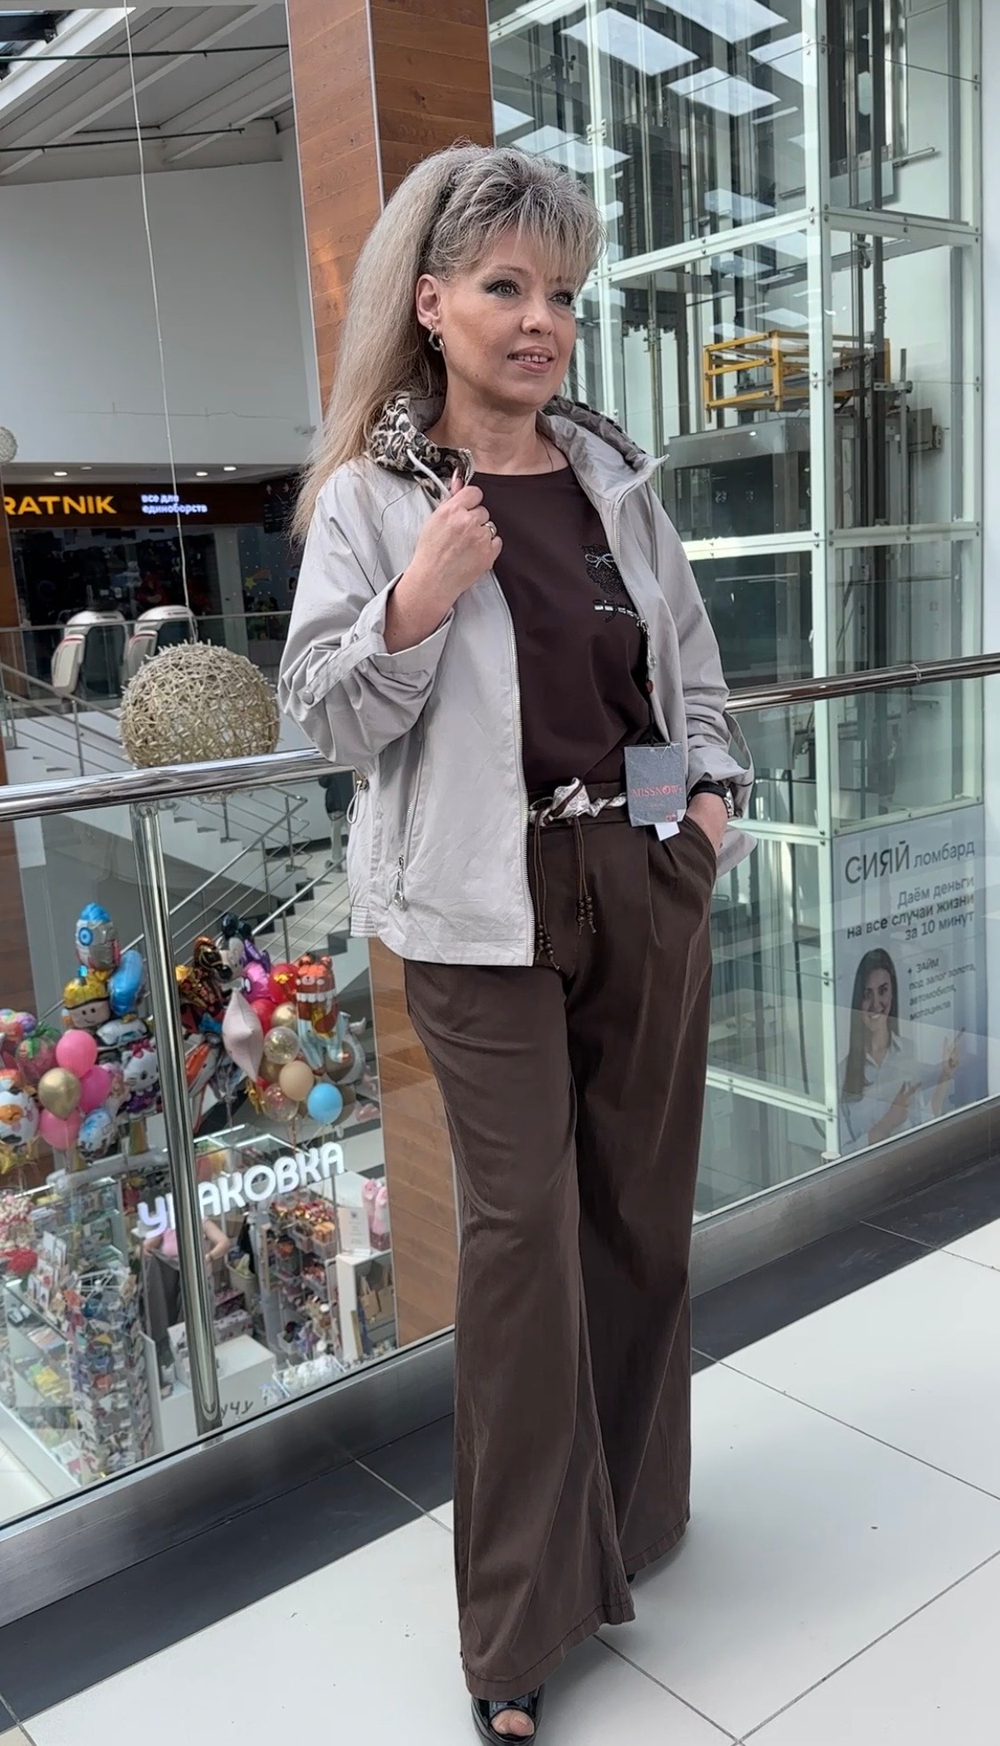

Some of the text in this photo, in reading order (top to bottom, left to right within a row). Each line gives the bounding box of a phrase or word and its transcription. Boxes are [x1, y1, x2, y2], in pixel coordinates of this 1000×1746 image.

[142, 503, 208, 515] единоборств
[845, 840, 976, 884] СИЯЙ ломбард
[897, 876, 974, 909] Даём деньги
[847, 894, 974, 939] на все случаи жизни
[905, 911, 975, 941] за 10 минут
